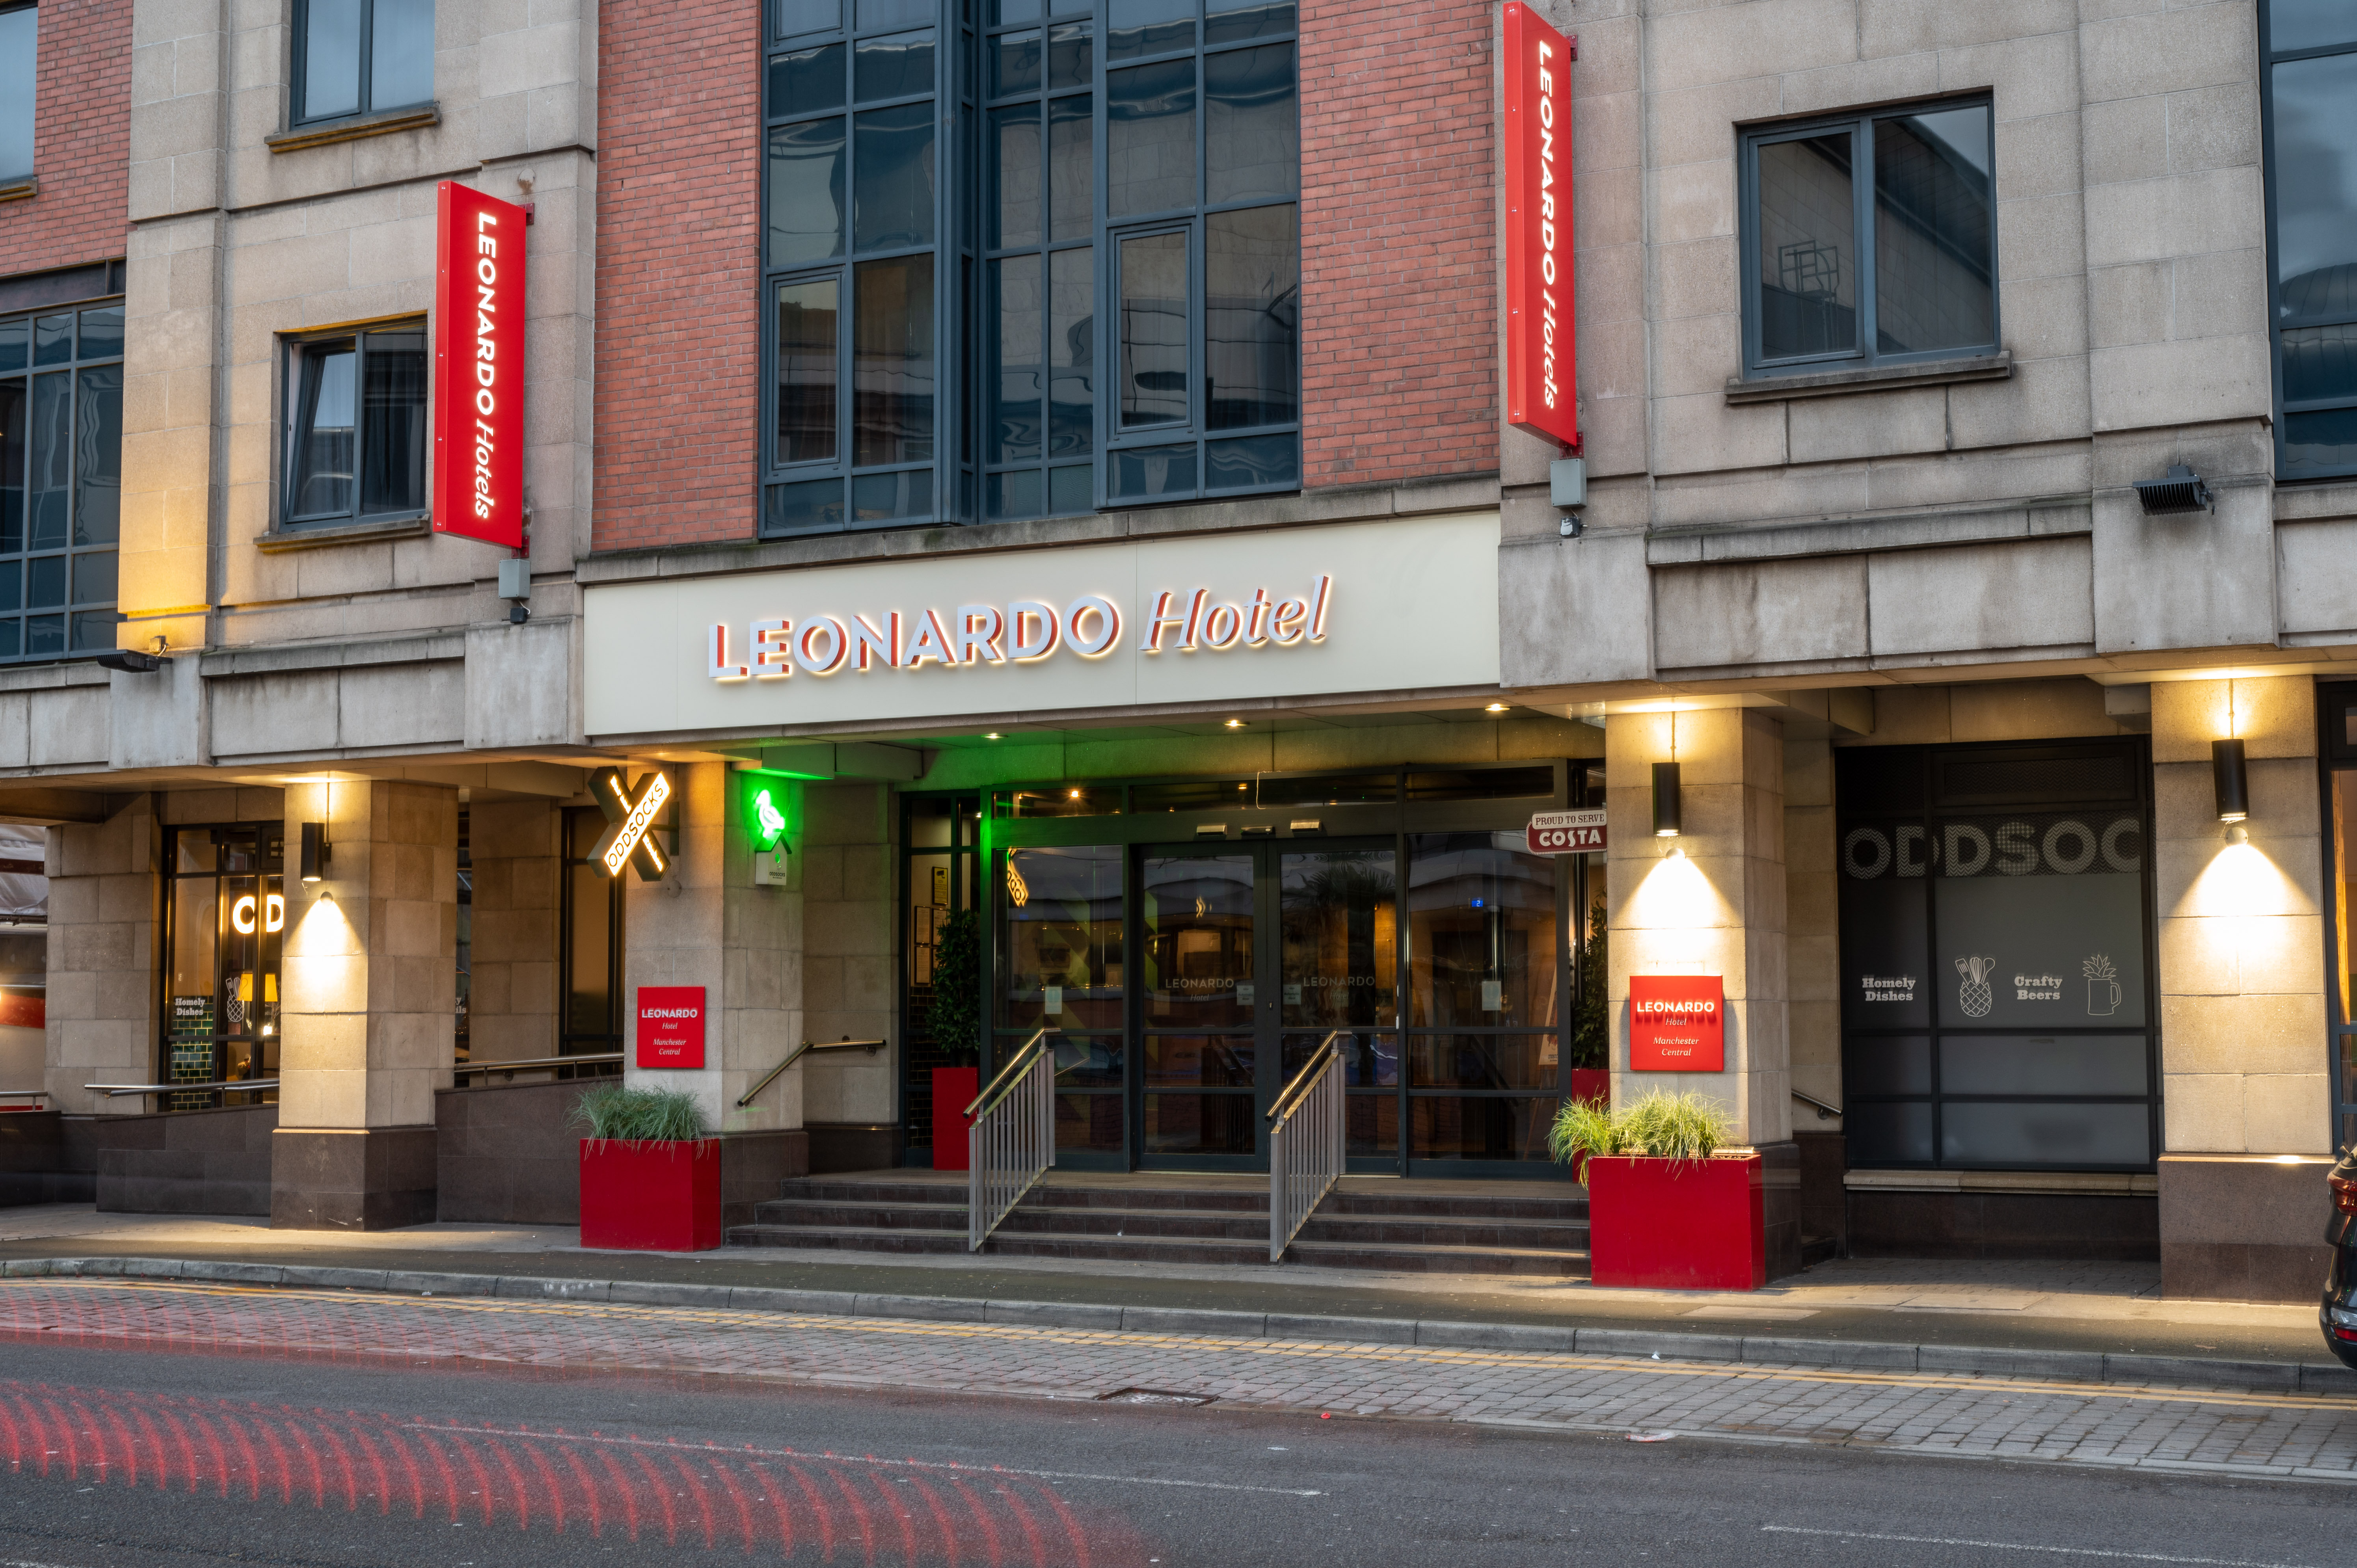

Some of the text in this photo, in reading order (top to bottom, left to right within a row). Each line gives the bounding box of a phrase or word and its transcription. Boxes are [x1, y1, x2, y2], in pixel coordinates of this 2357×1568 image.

[1539, 40, 1558, 409] LEONARDO Hotels
[475, 211, 497, 519] LEONARDO Hotels
[709, 576, 1329, 679] LEONARDO Hotel
[609, 784, 663, 867] ODDSOCKS
[1536, 814, 1604, 826] PROUD TO SERVE
[1539, 830, 1601, 847] COSTA
[1165, 978, 1234, 988] LEONARDO
[1303, 977, 1375, 987] LEONARDO
[1862, 977, 1916, 990] Homely
[2014, 976, 2063, 989] Crafty
[1865, 991, 1913, 1001] Dishes
[2017, 990, 2060, 1000] Beers
[175, 998, 205, 1007] Homely
[1637, 1001, 1715, 1012] LEONARDO
[642, 1009, 697, 1018] LEONARDO
